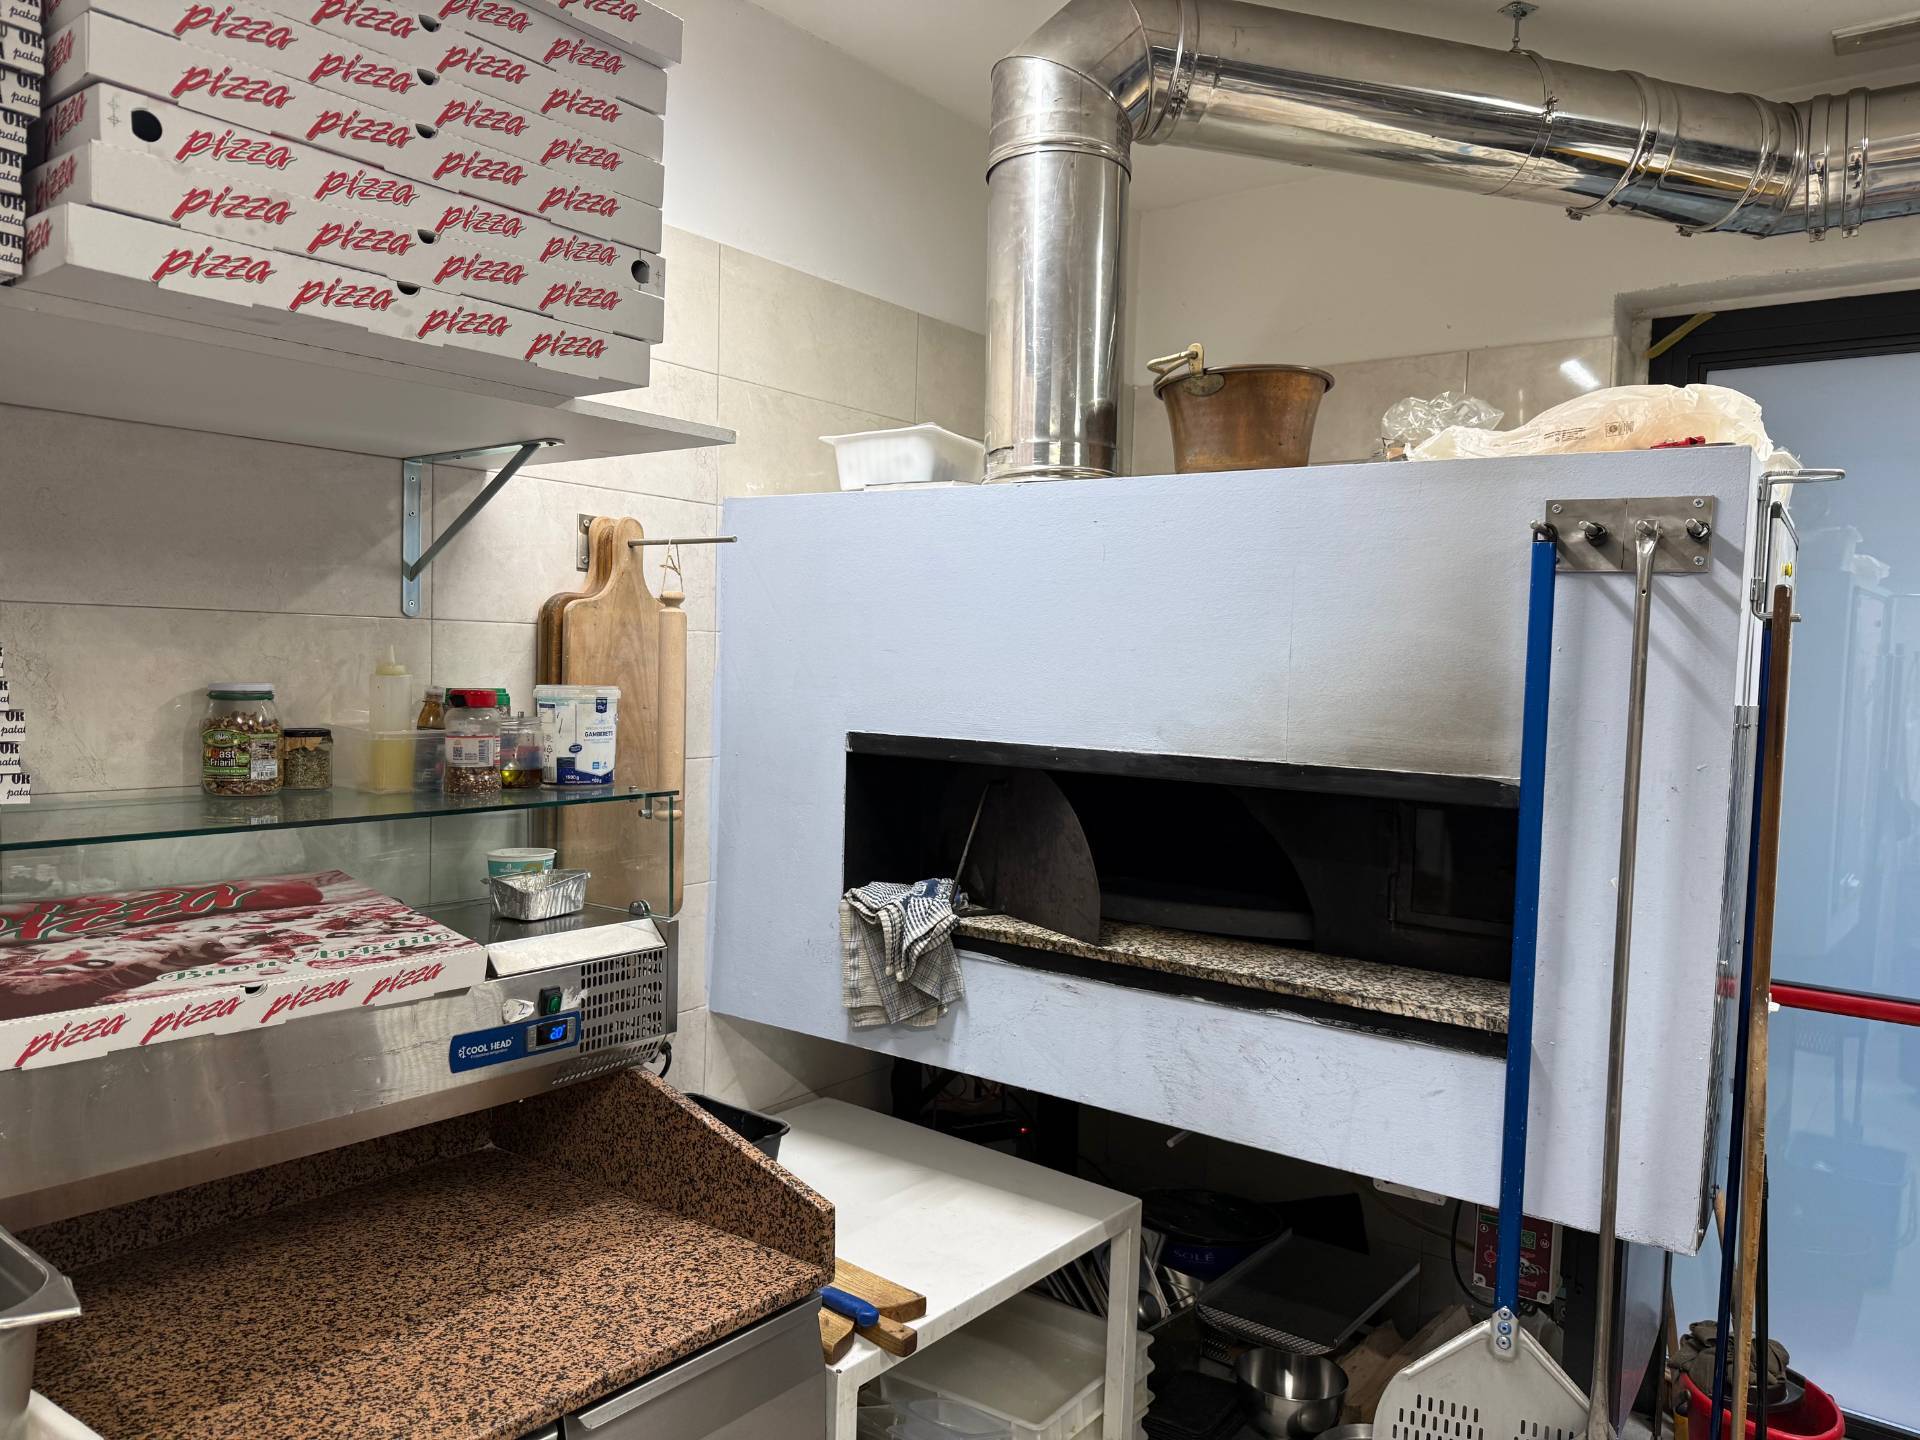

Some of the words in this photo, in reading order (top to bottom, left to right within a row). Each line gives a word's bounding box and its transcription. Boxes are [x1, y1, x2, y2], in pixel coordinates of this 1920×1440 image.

[174, 4, 296, 49] pizza
[311, 0, 420, 39] pizza
[439, 0, 534, 33] pizza
[436, 46, 532, 82] pizza
[543, 38, 626, 73] pizza
[171, 65, 295, 108] pizza
[308, 53, 417, 94] pizza
[435, 99, 531, 136] pizza
[541, 89, 624, 121] pizza
[307, 110, 415, 147] pizza
[175, 128, 295, 168] pizza
[542, 138, 625, 170] pizza
[433, 151, 529, 186] pizza
[171, 185, 295, 224] pizza
[314, 170, 419, 204] pizza
[538, 186, 622, 216] pizza
[307, 222, 416, 255] pizza
[434, 206, 527, 237] pizza
[151, 245, 278, 282] pizza
[539, 238, 620, 264] pizza
[434, 255, 529, 285] pizza
[289, 278, 398, 312] pizza
[539, 282, 624, 311] pizza
[417, 308, 513, 338] pizza
[525, 332, 609, 360] pizza
[0, 882, 257, 941] izza
[155, 960, 282, 982] Buon
[293, 932, 454, 964] Appetito
[259, 976, 354, 1025] pizza
[361, 961, 447, 1006] pizza
[138, 994, 246, 1047] pizza
[14, 1011, 132, 1068] pizza
[466, 1043, 488, 1055] COOL
[490, 1038, 512, 1051] HEAD
